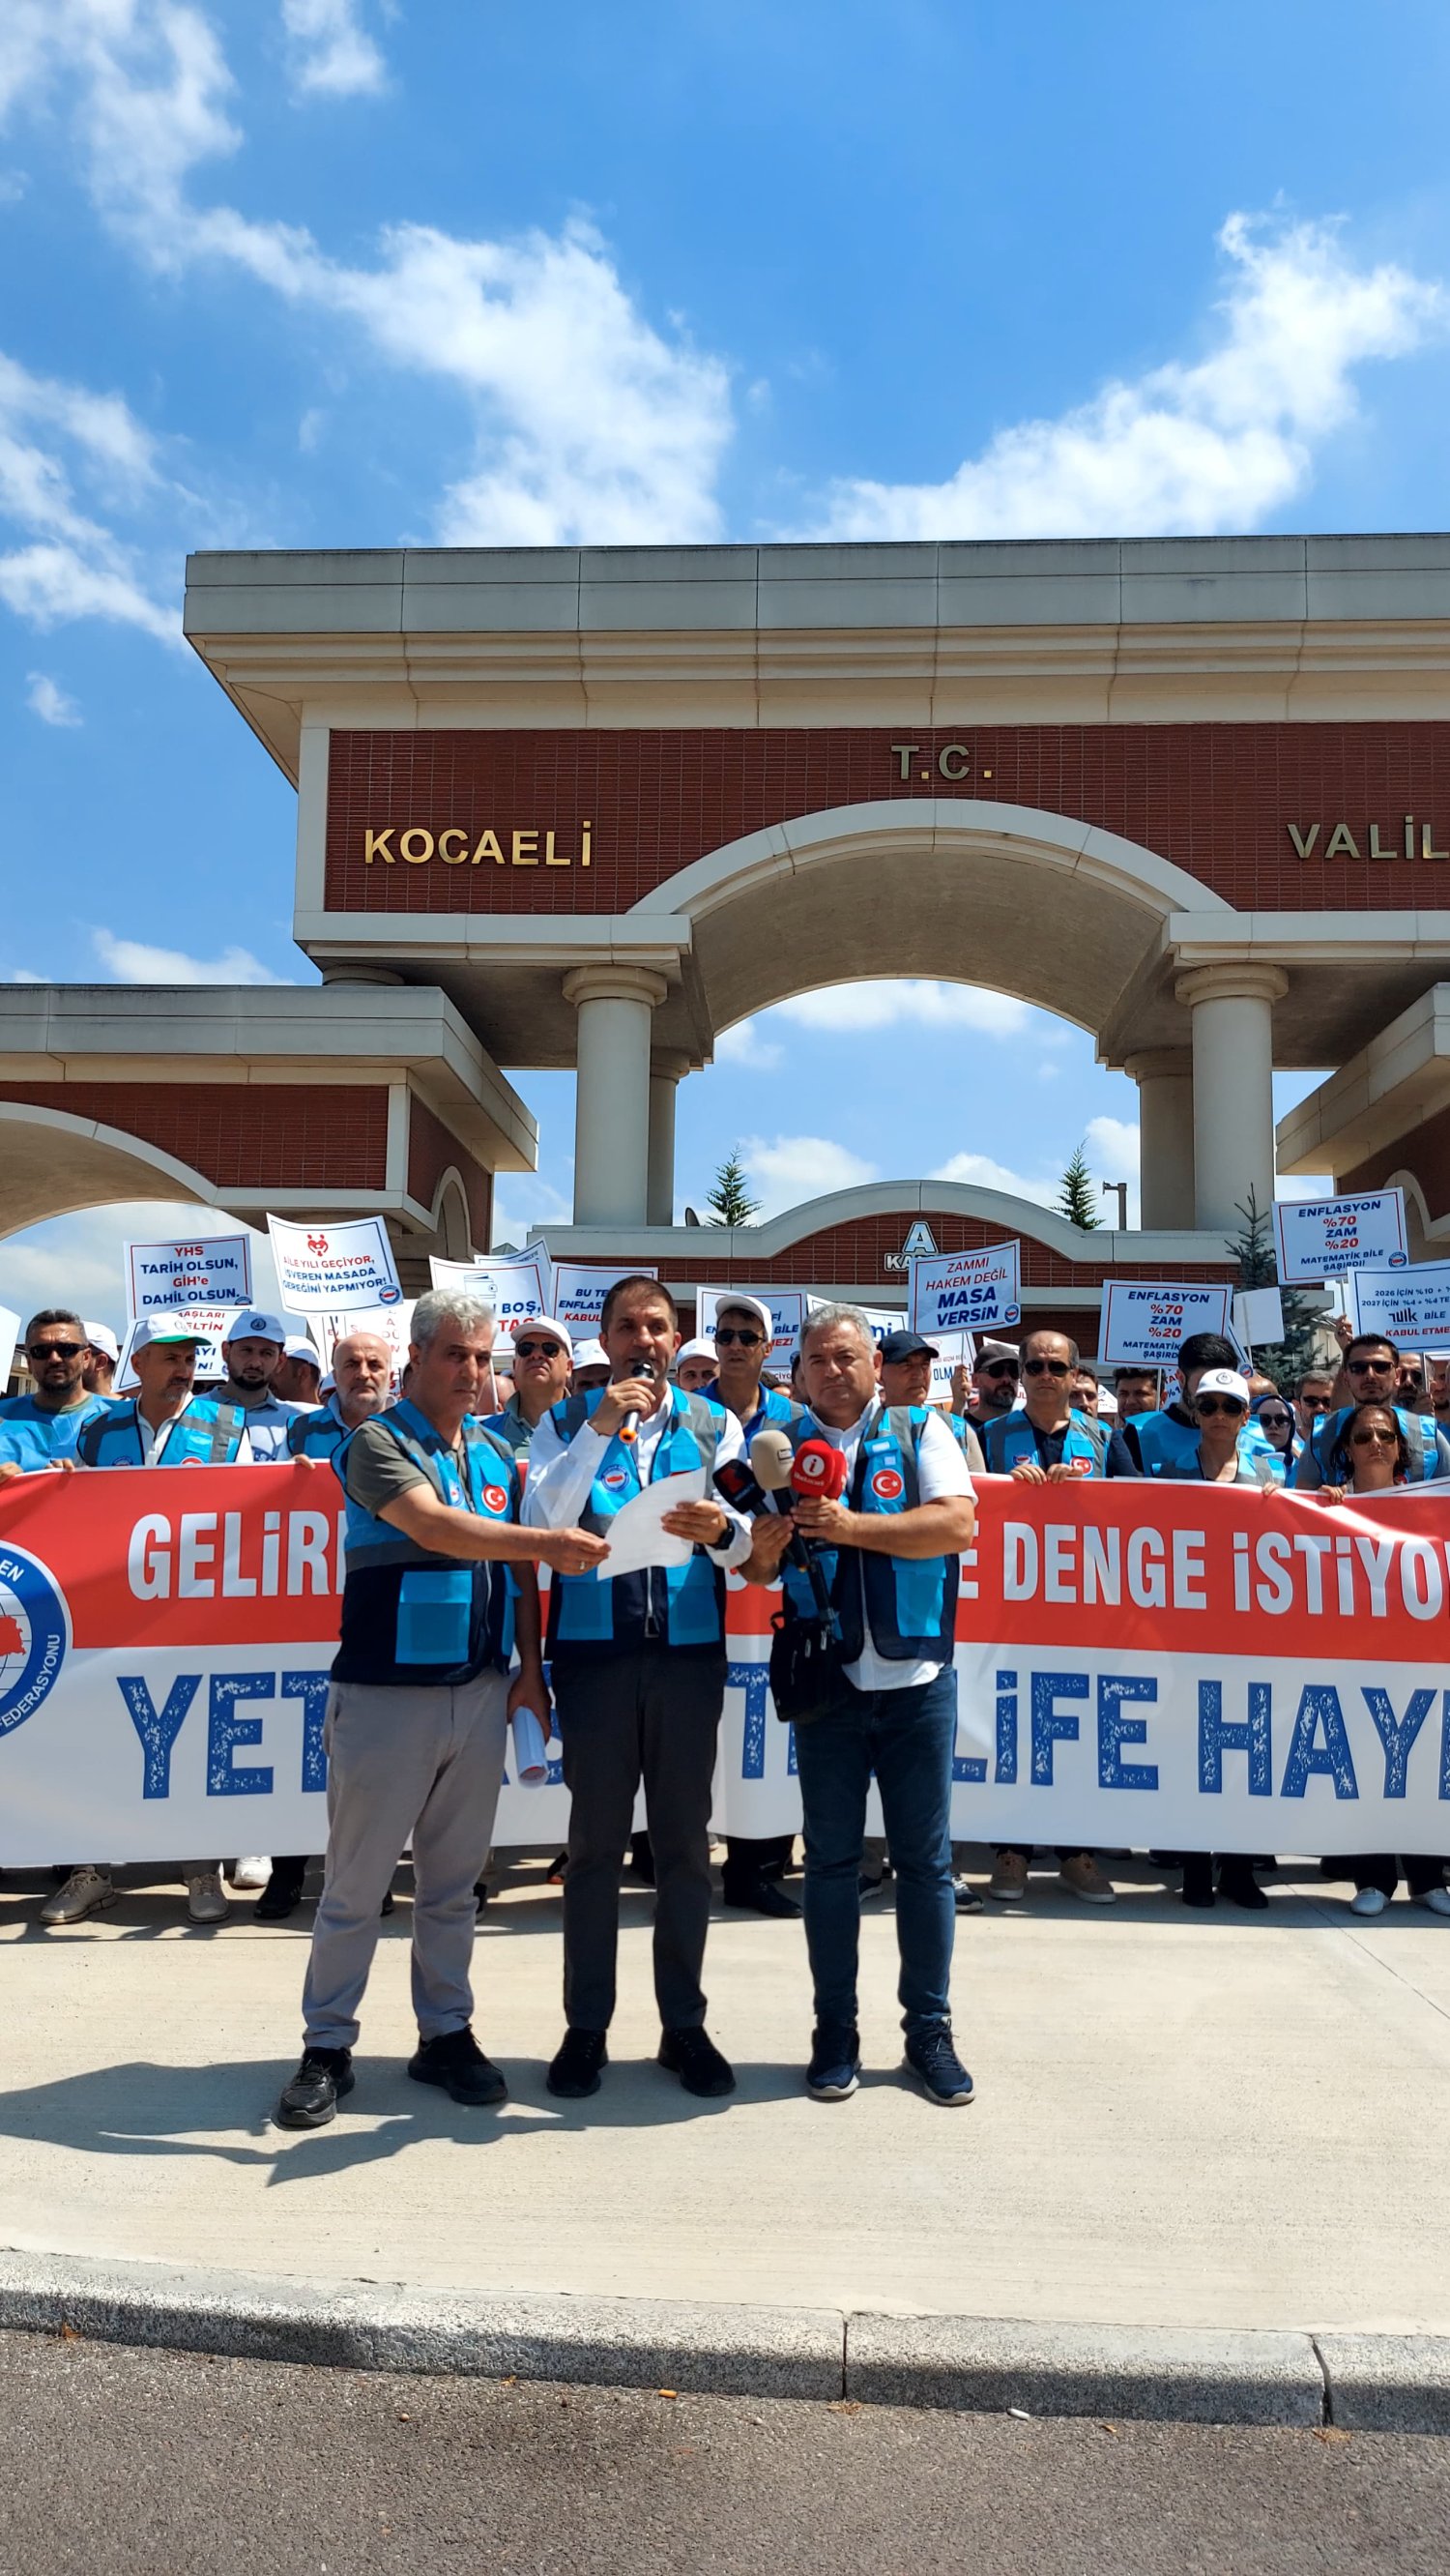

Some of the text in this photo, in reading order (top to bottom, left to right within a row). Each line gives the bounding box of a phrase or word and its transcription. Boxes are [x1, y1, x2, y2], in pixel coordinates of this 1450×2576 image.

[890, 744, 992, 780] T.C.
[363, 820, 592, 866] KOCAELİ
[1287, 815, 1450, 860] VALİL
[1298, 1200, 1381, 1217] ENFLASYON
[1322, 1215, 1357, 1228] %70
[903, 1221, 938, 1253] A
[1325, 1227, 1357, 1238] ZAM
[1324, 1238, 1359, 1250] %20
[174, 1245, 204, 1257] YHS
[1300, 1249, 1384, 1265] MATEMATİK BİLE
[140, 1258, 239, 1274] TARİH OLSUN,
[321, 1255, 375, 1269] GEÇİYOR,
[946, 1257, 990, 1273] ZAMMI
[324, 1268, 376, 1280] MASADA
[925, 1267, 1008, 1291] HAKEM DEĞİL
[323, 1277, 388, 1294] YAPMIYOR!
[142, 1288, 240, 1304] DAHİL OLSUN.
[575, 1288, 592, 1297] BU
[937, 1286, 997, 1309] MASA
[1128, 1291, 1210, 1303] ENFLASYON
[1396, 1288, 1413, 1297] İÇİN
[502, 1300, 541, 1315] BOŞ,
[559, 1300, 602, 1310] ENFLAS
[1150, 1303, 1184, 1315] %70
[1381, 1299, 1399, 1307] İÇİN
[1150, 1316, 1182, 1326] ZAM
[1424, 1310, 1447, 1320] BİLE
[773, 1323, 799, 1334] BİLE
[1148, 1327, 1182, 1338] %20
[1422, 1326, 1450, 1335] ETME
[1122, 1340, 1181, 1350] MATEMATİK
[1143, 1350, 1179, 1360] ŞAŞIRD
[0, 1559, 25, 1582] EN
[1002, 1521, 1207, 1610] DENGE
[0, 1634, 61, 1728] EDERASYONU
[116, 1670, 333, 1800] YET
